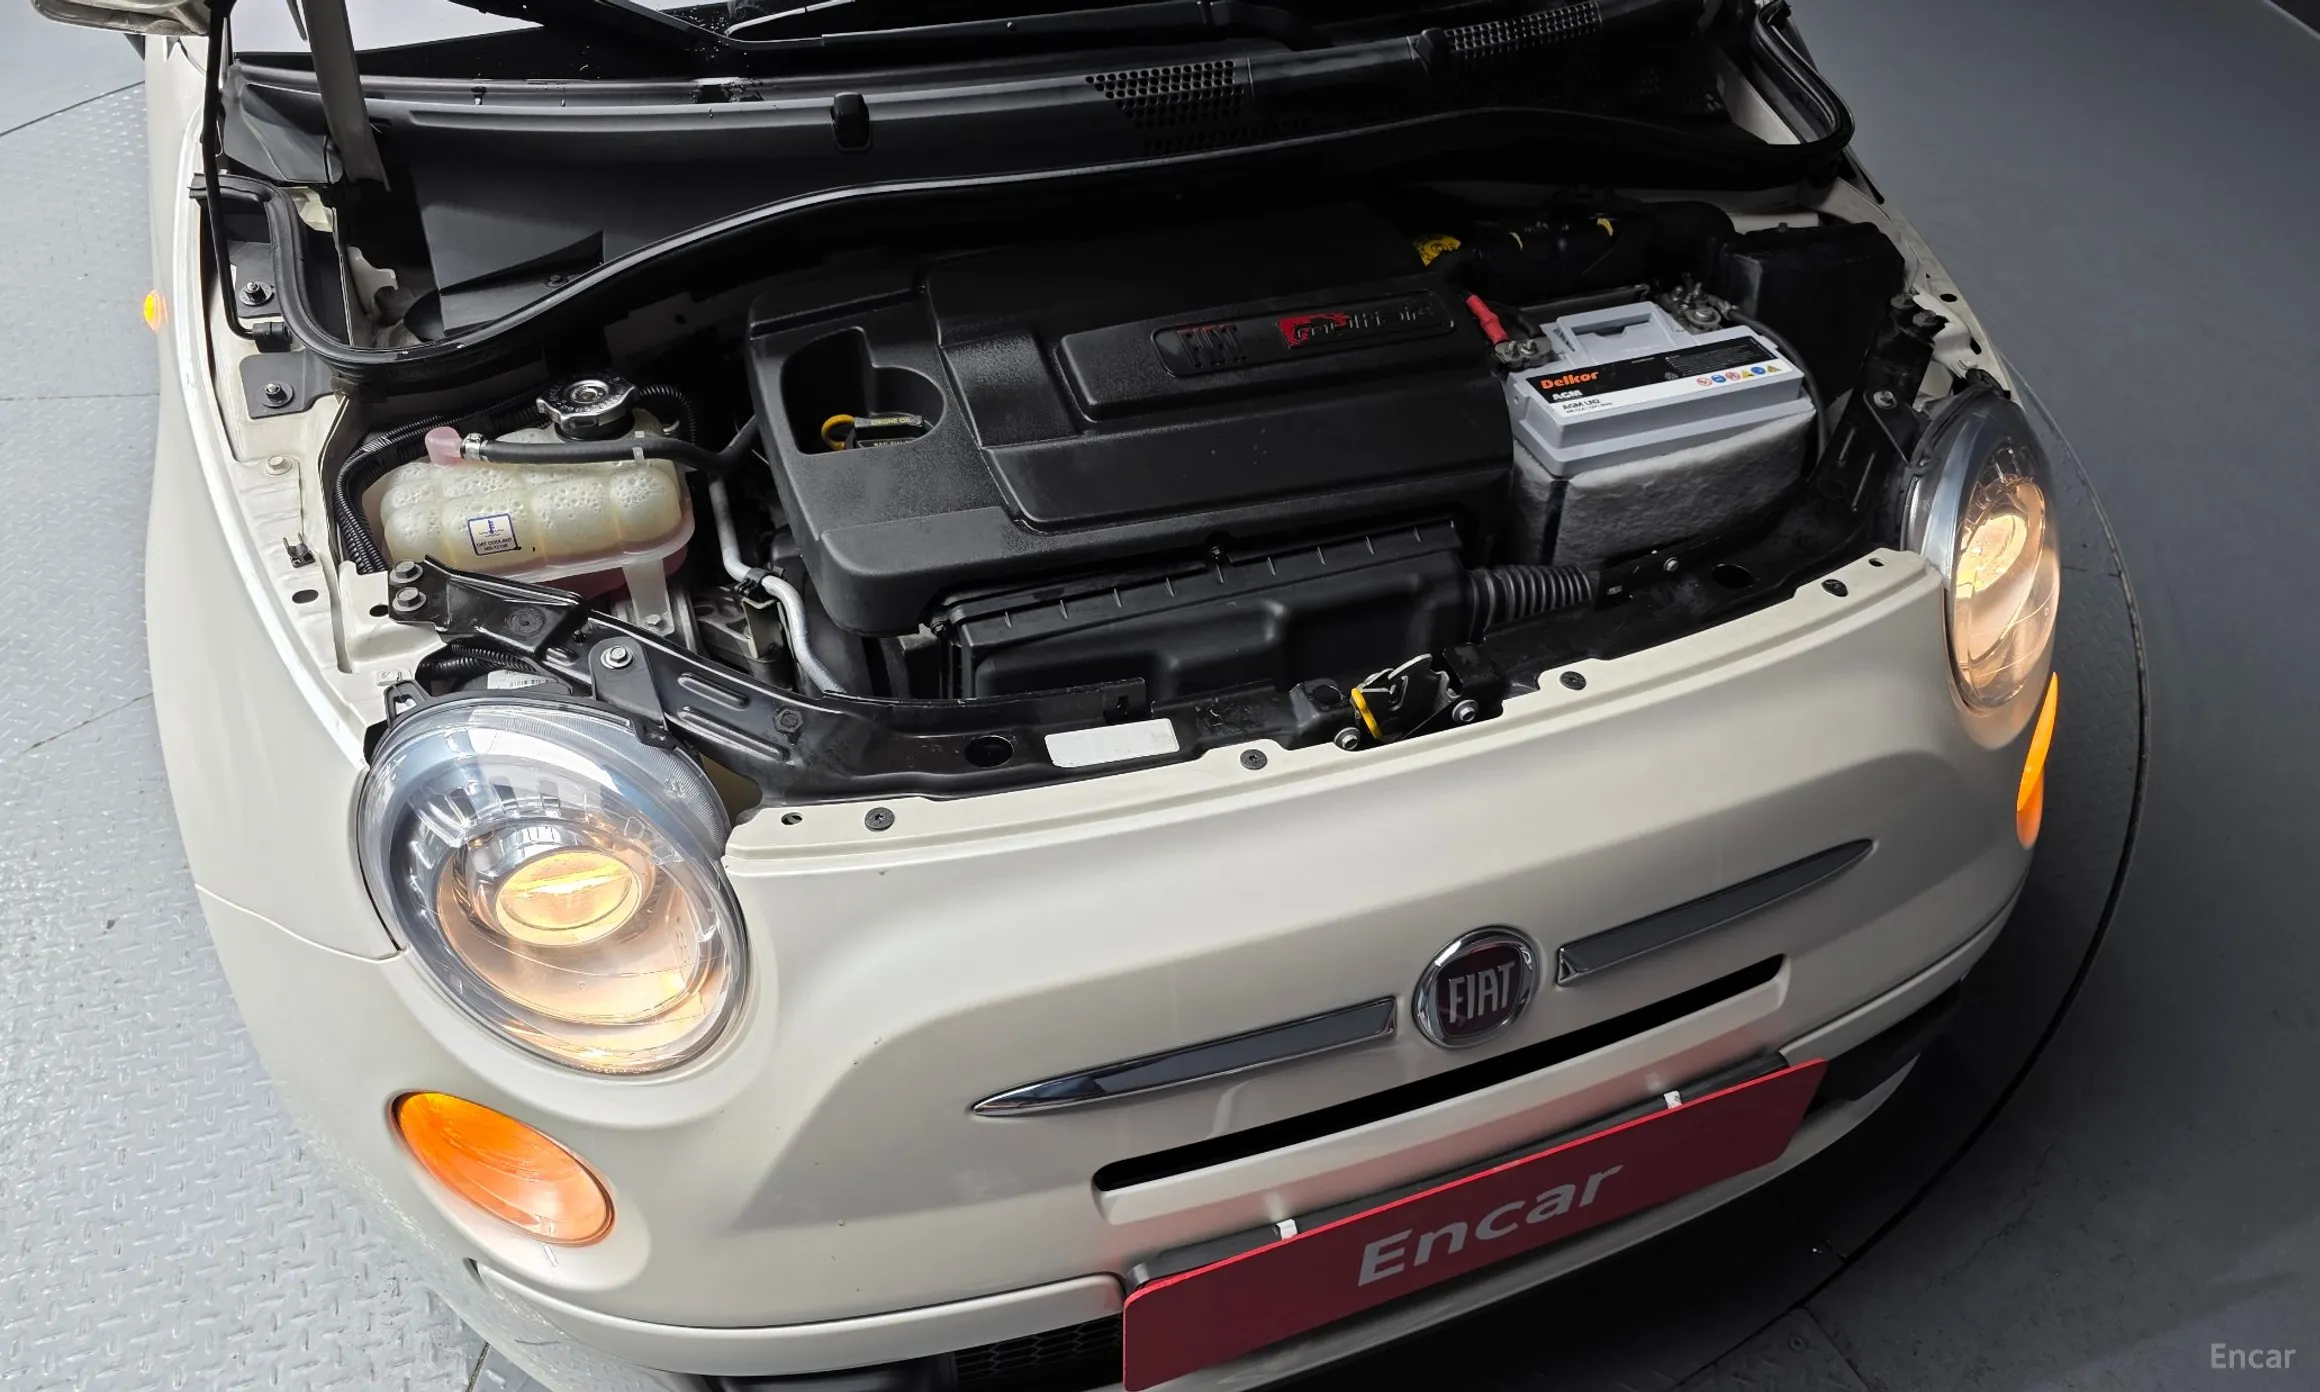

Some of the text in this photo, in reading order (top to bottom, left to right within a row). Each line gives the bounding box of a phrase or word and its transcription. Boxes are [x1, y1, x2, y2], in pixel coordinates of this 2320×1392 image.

[1541, 371, 1599, 389] Delkor
[1552, 389, 1583, 401] AGM
[1448, 961, 1515, 1024] FIAT
[1358, 1165, 1623, 1287] Encar
